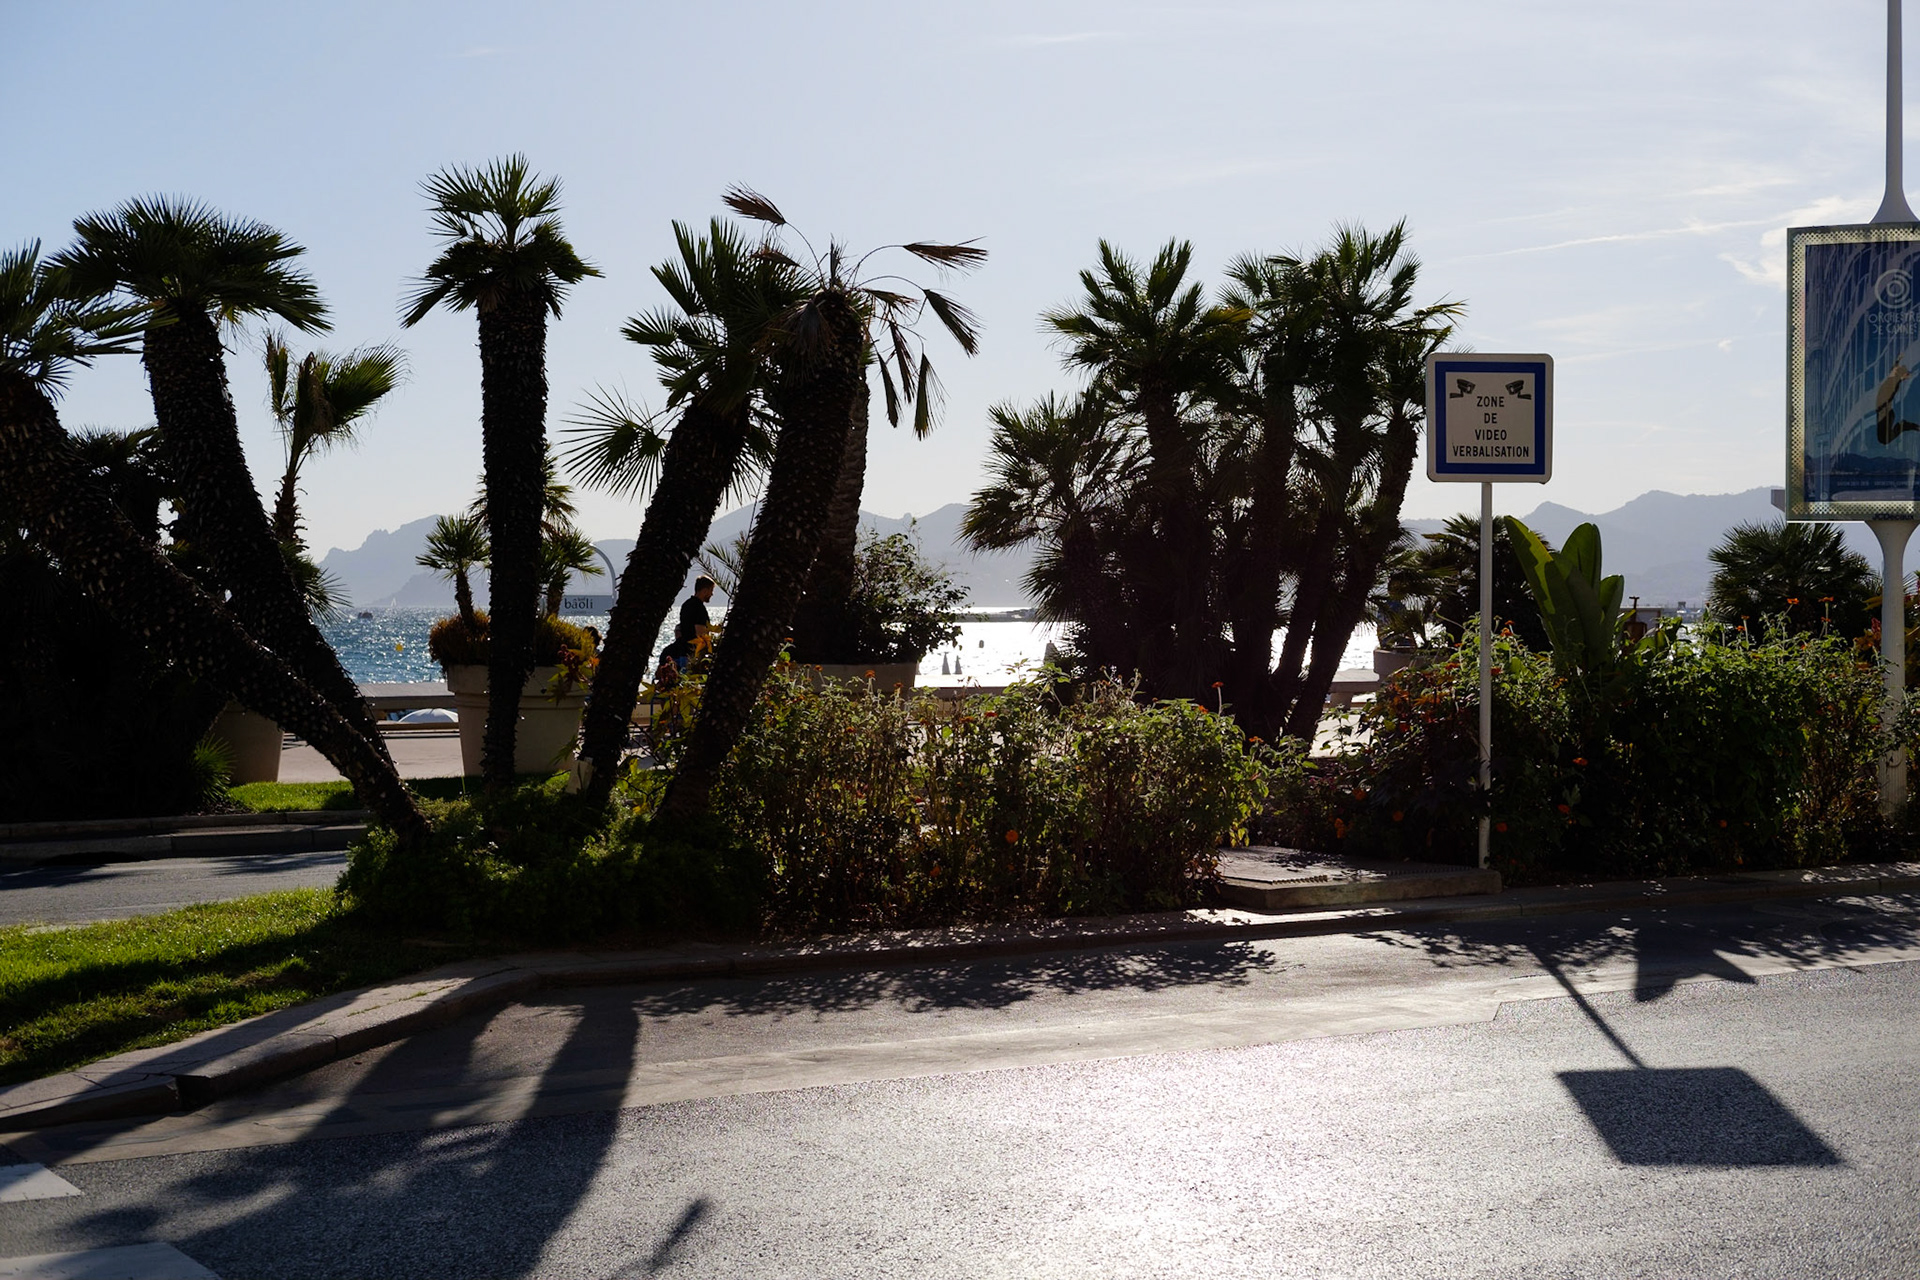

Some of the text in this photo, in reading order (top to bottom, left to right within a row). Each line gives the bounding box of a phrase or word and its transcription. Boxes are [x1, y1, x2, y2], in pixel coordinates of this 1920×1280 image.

[1868, 311, 1920, 323] ORCHESTRE
[1872, 323, 1918, 335] DE CANNES
[1476, 396, 1505, 407] ZONE
[1484, 413, 1498, 424] DE
[1475, 429, 1508, 441] VIDEO
[1453, 446, 1529, 458] VERBALISATION
